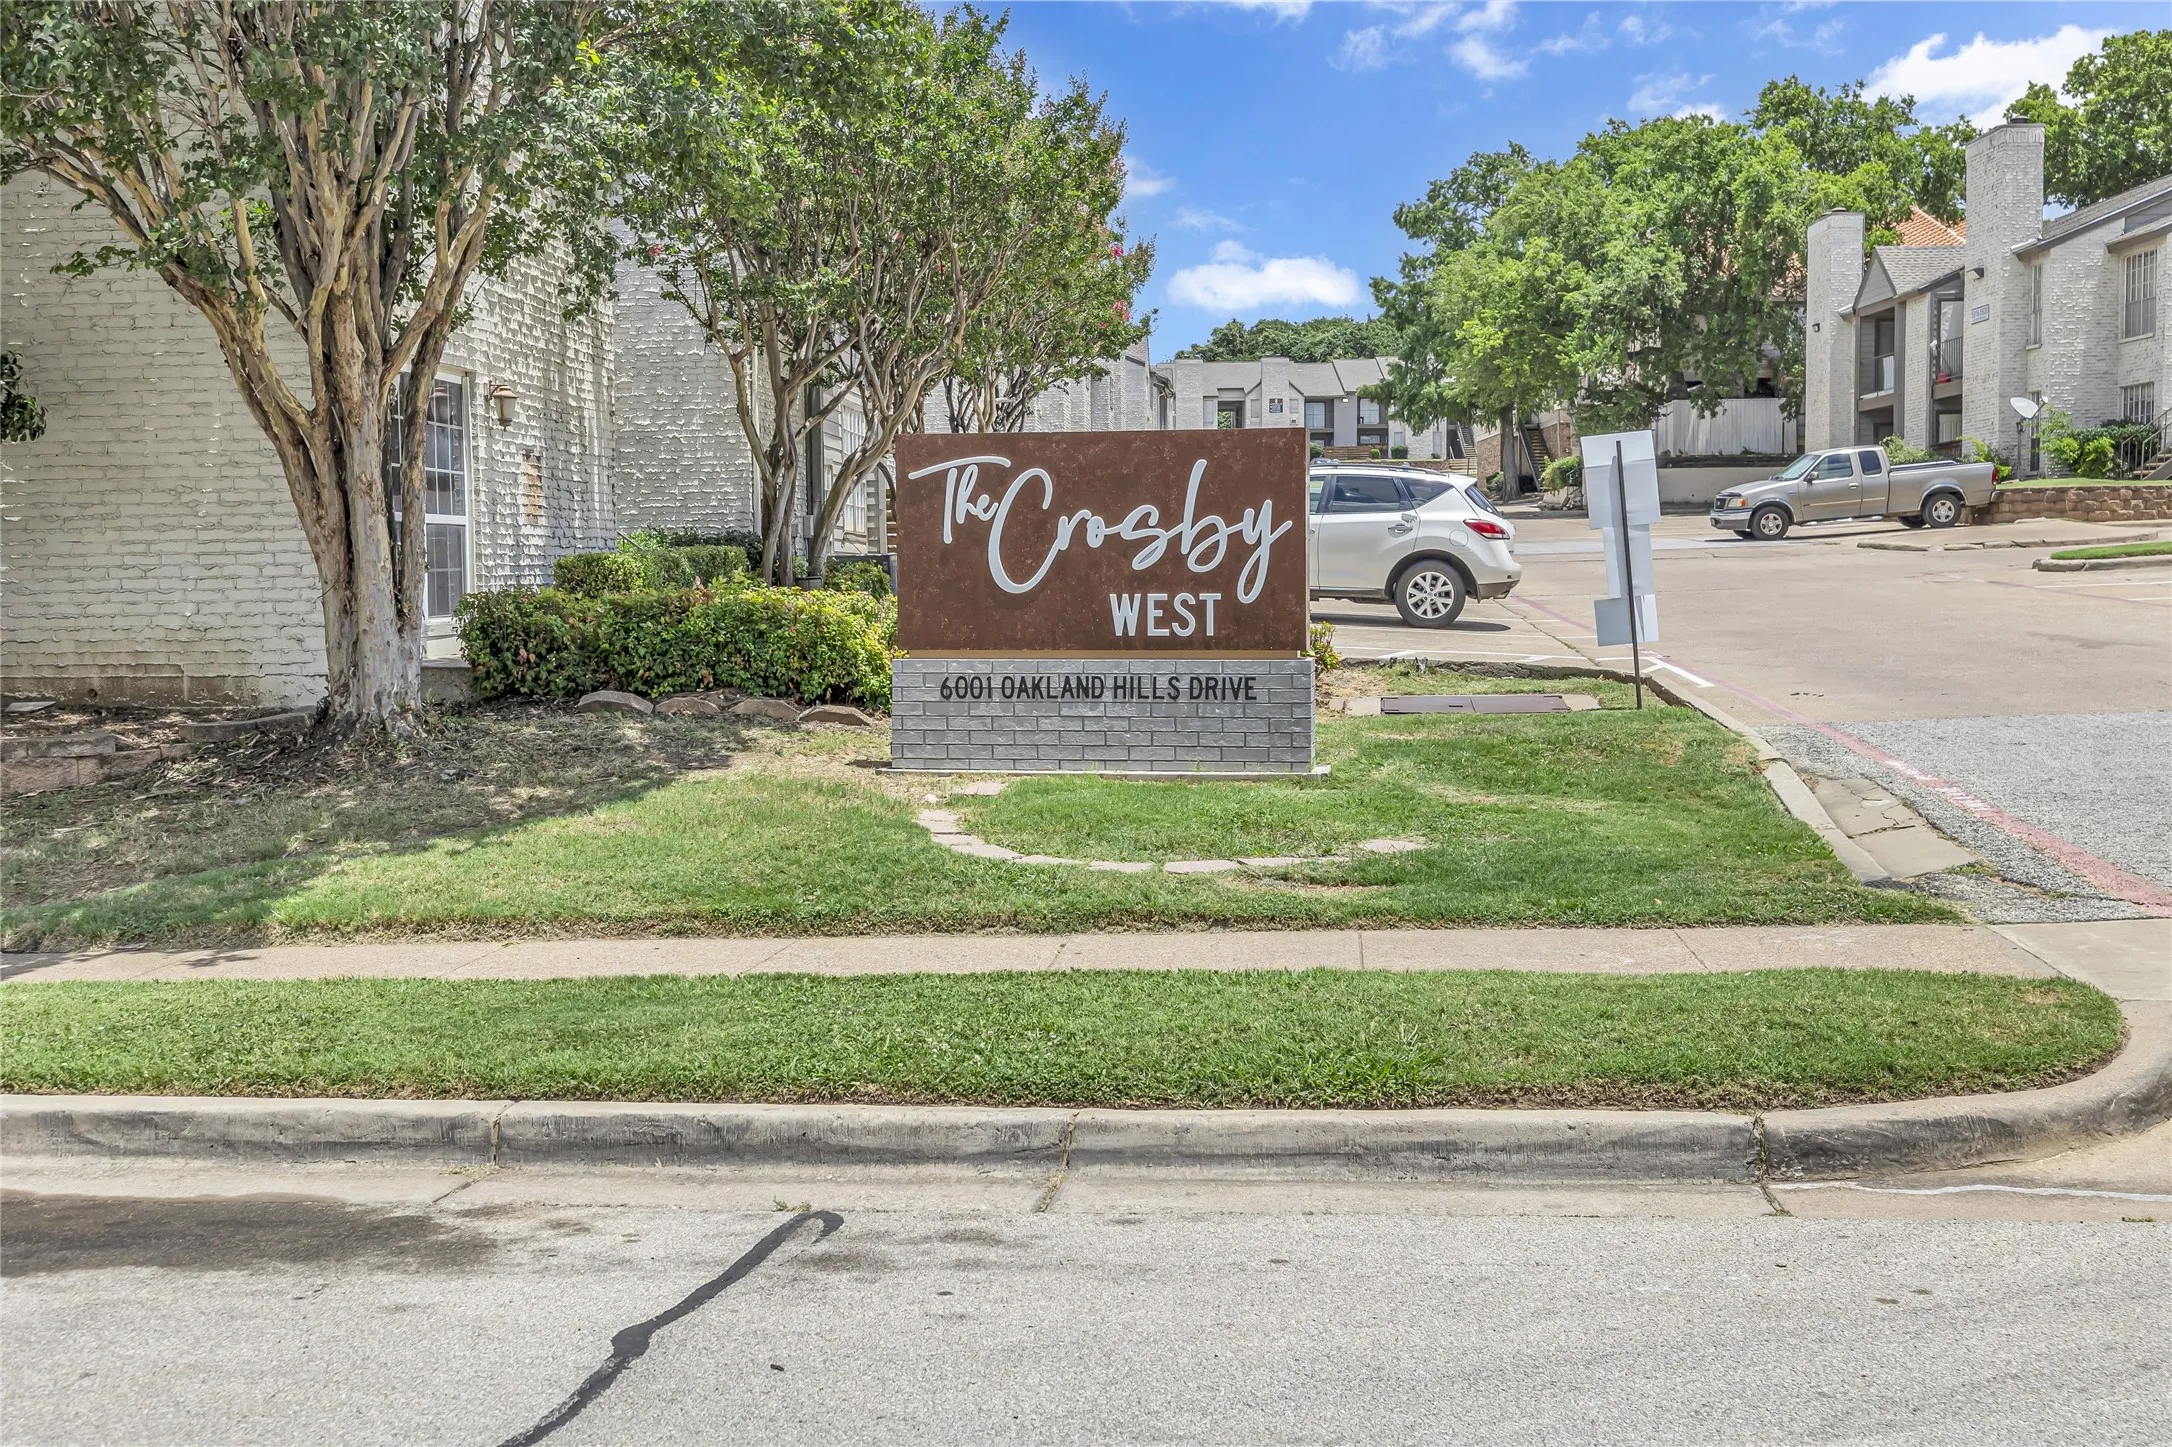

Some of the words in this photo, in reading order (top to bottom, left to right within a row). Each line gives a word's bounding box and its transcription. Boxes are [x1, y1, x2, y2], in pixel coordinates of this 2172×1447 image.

[907, 455, 1011, 544] The
[987, 458, 1293, 604] Crosby
[1109, 592, 1222, 637] WEST
[939, 675, 993, 700] 6001
[1001, 675, 1104, 700] OAKLAND
[1113, 675, 1181, 701] HILLS
[1189, 676, 1257, 701] DRIVE
